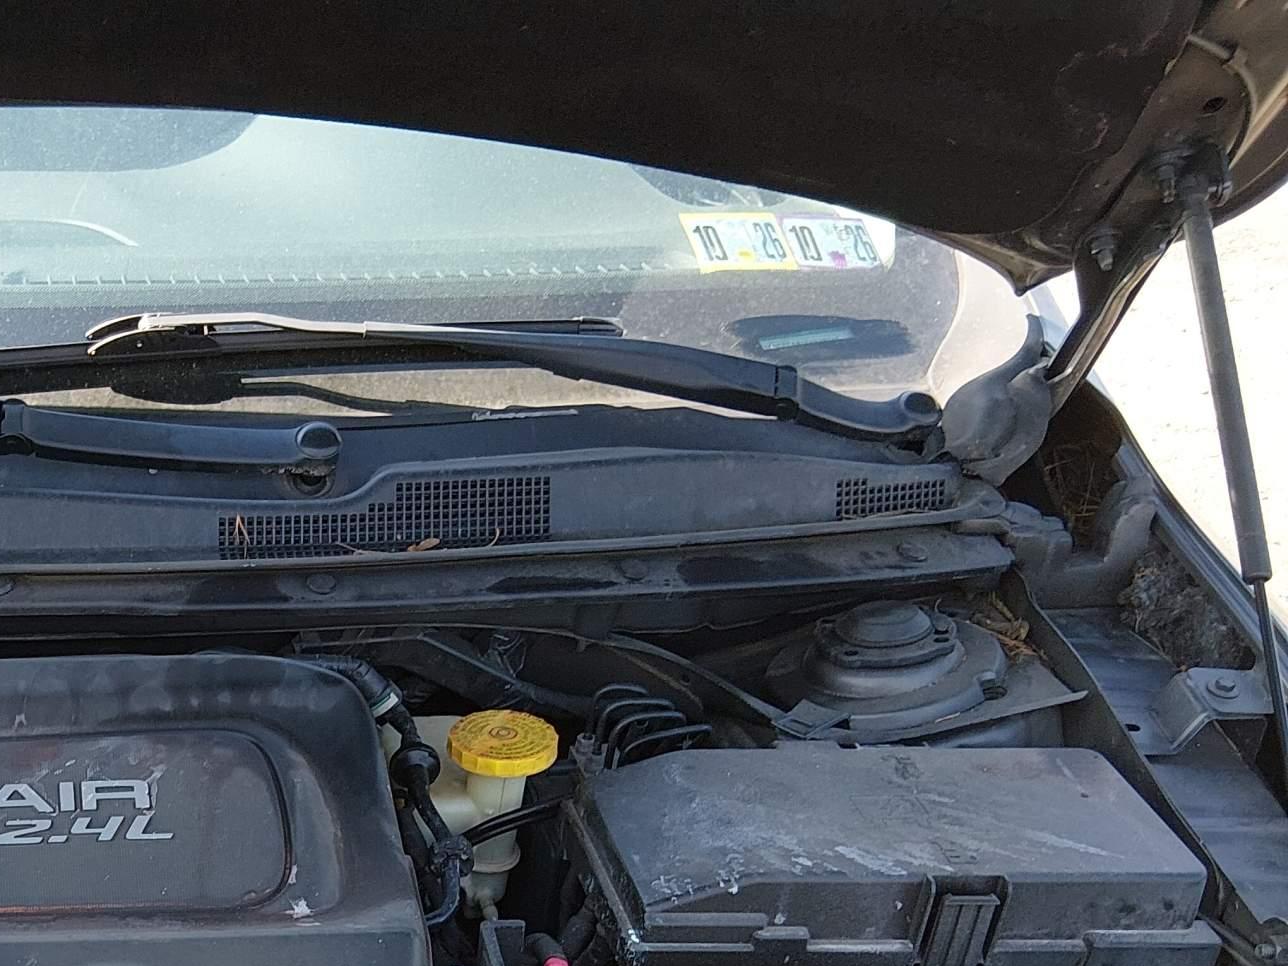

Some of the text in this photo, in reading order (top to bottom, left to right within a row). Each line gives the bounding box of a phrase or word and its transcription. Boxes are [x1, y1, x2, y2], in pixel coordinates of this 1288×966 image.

[693, 222, 787, 261] 10 26
[789, 225, 823, 262] 10
